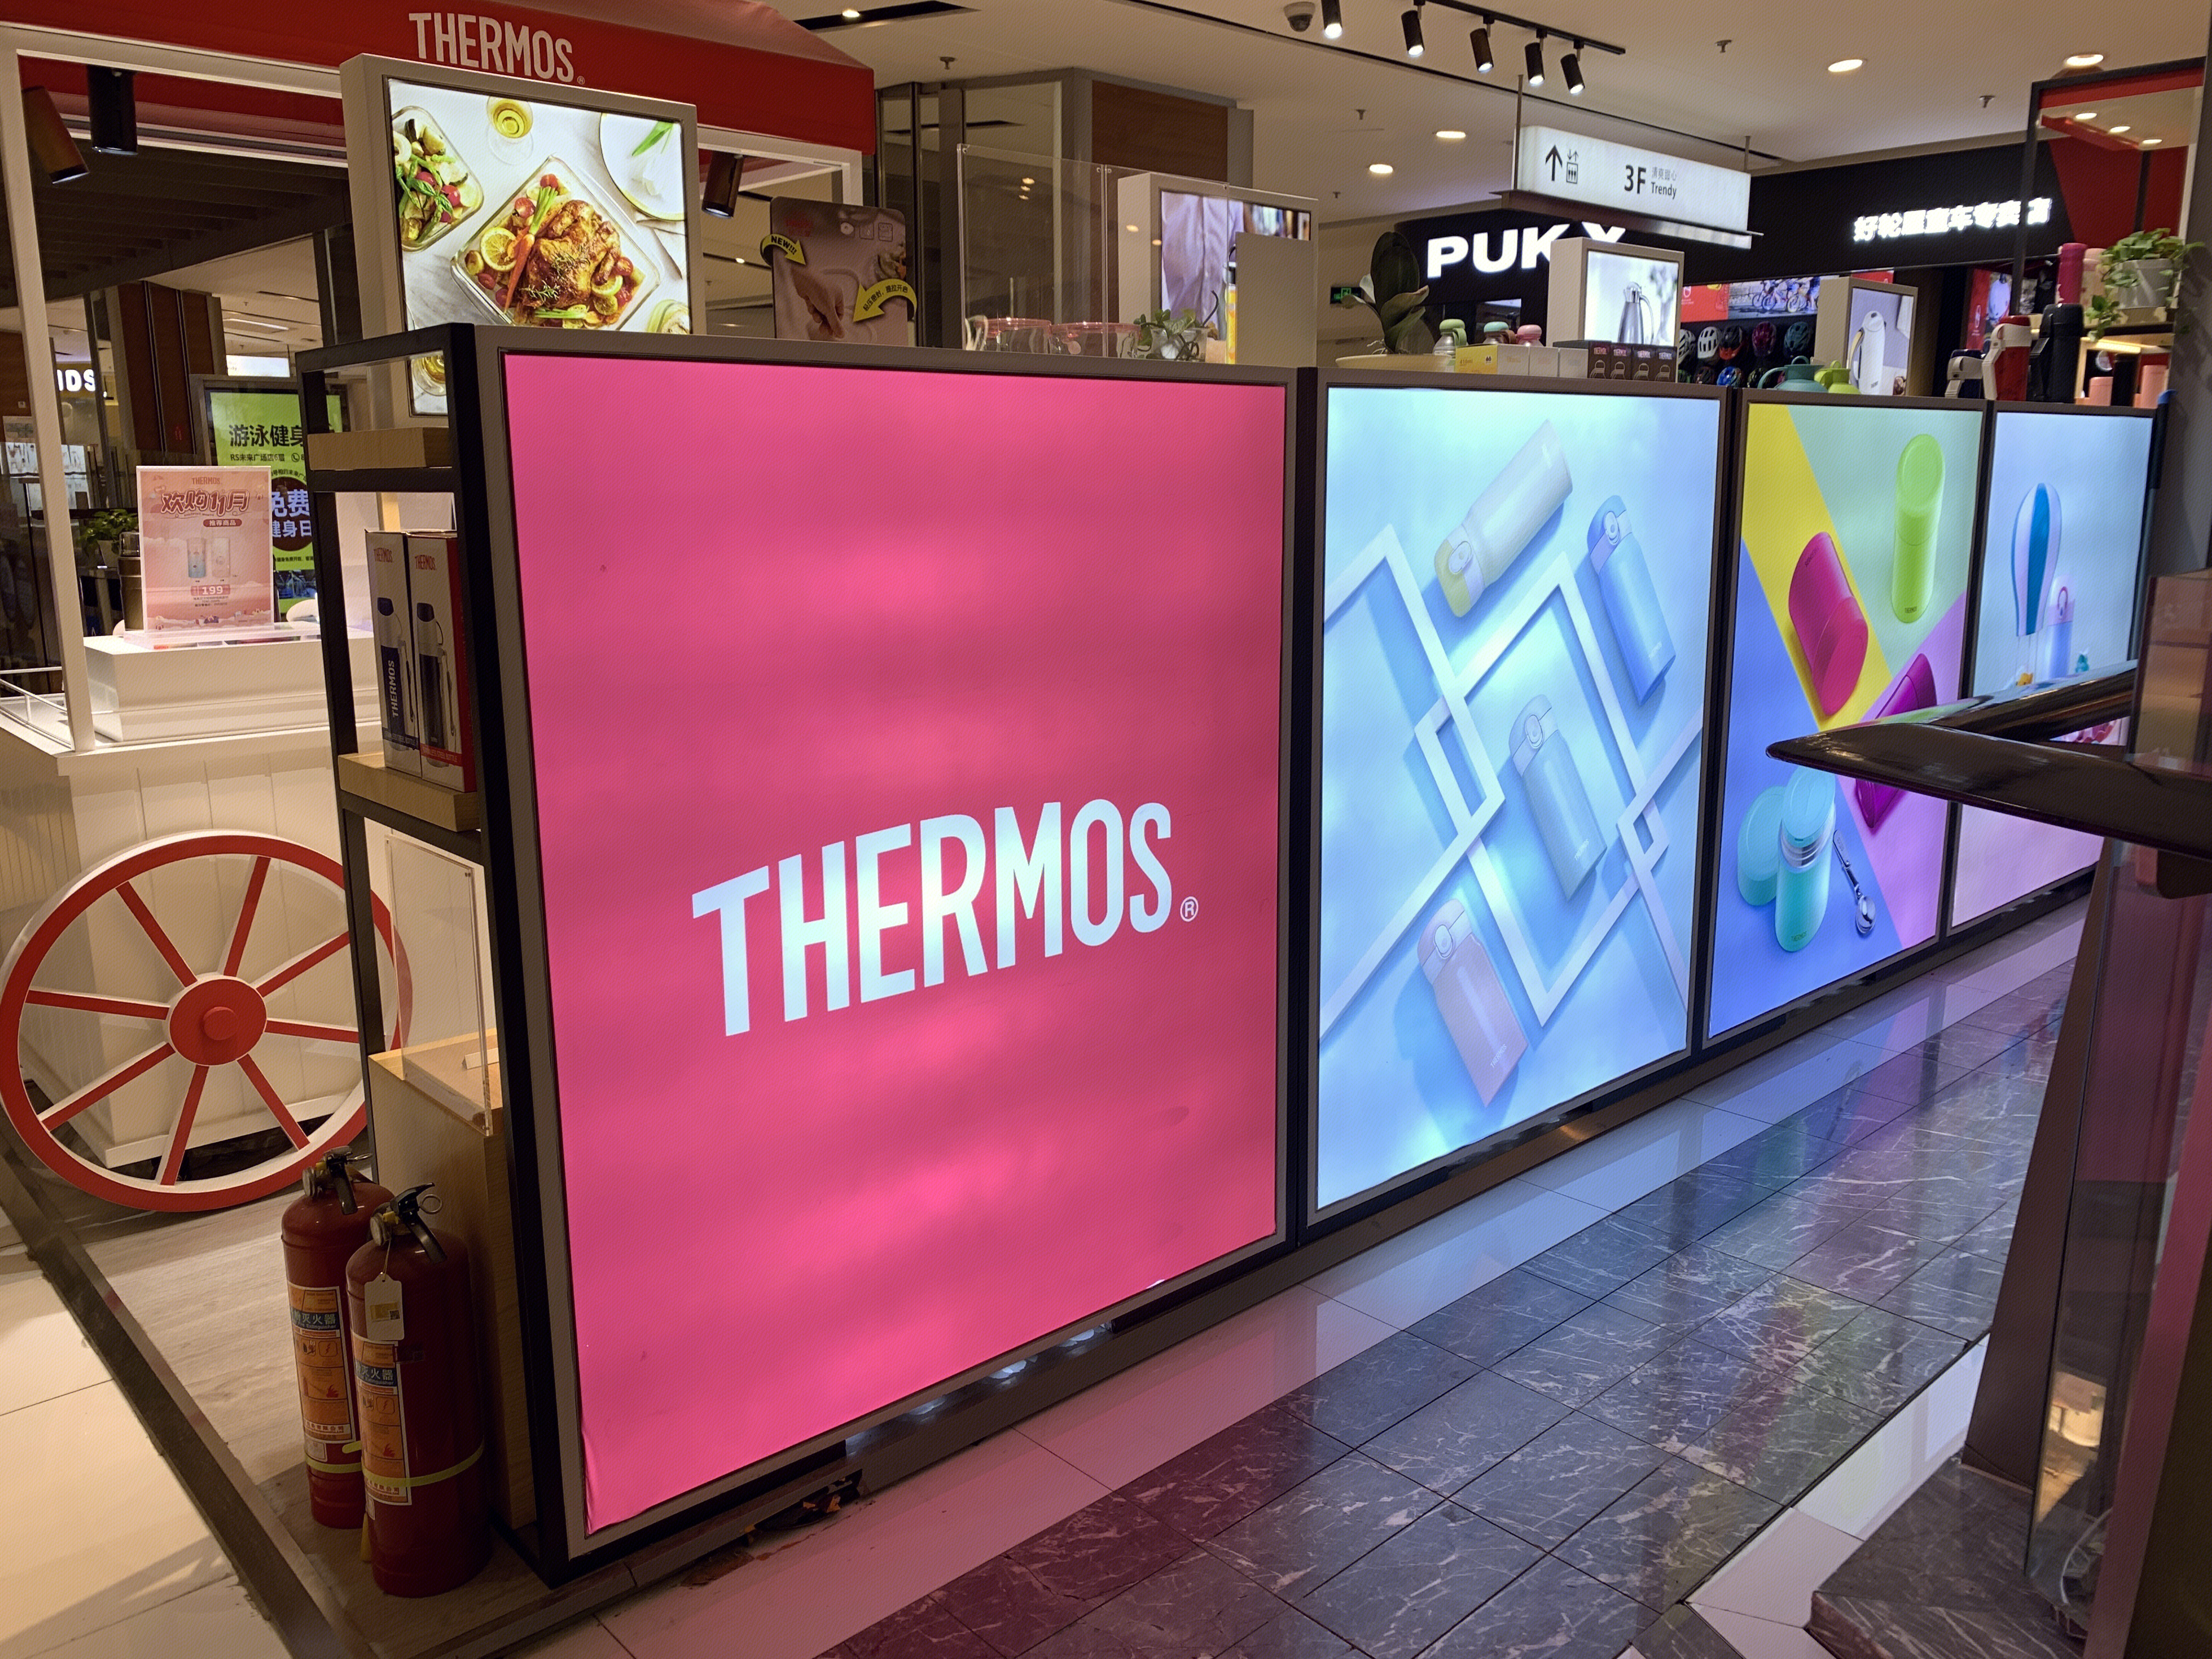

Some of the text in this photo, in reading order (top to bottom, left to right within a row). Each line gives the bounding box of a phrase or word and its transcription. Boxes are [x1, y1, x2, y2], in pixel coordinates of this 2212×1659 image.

[408, 12, 574, 83] THERMOS
[1624, 163, 1677, 200] 3F Trendy
[770, 235, 798, 255] NEW!!!
[228, 424, 304, 447] 游泳健身
[191, 476, 221, 485] THERMOS
[374, 548, 393, 563] THERMOS
[415, 555, 436, 571] THERMOS
[202, 585, 223, 595] 199
[388, 660, 399, 718] THERMOS
[692, 798, 1172, 1037] THERMOS
[1490, 1043, 1507, 1068] THERMOS
